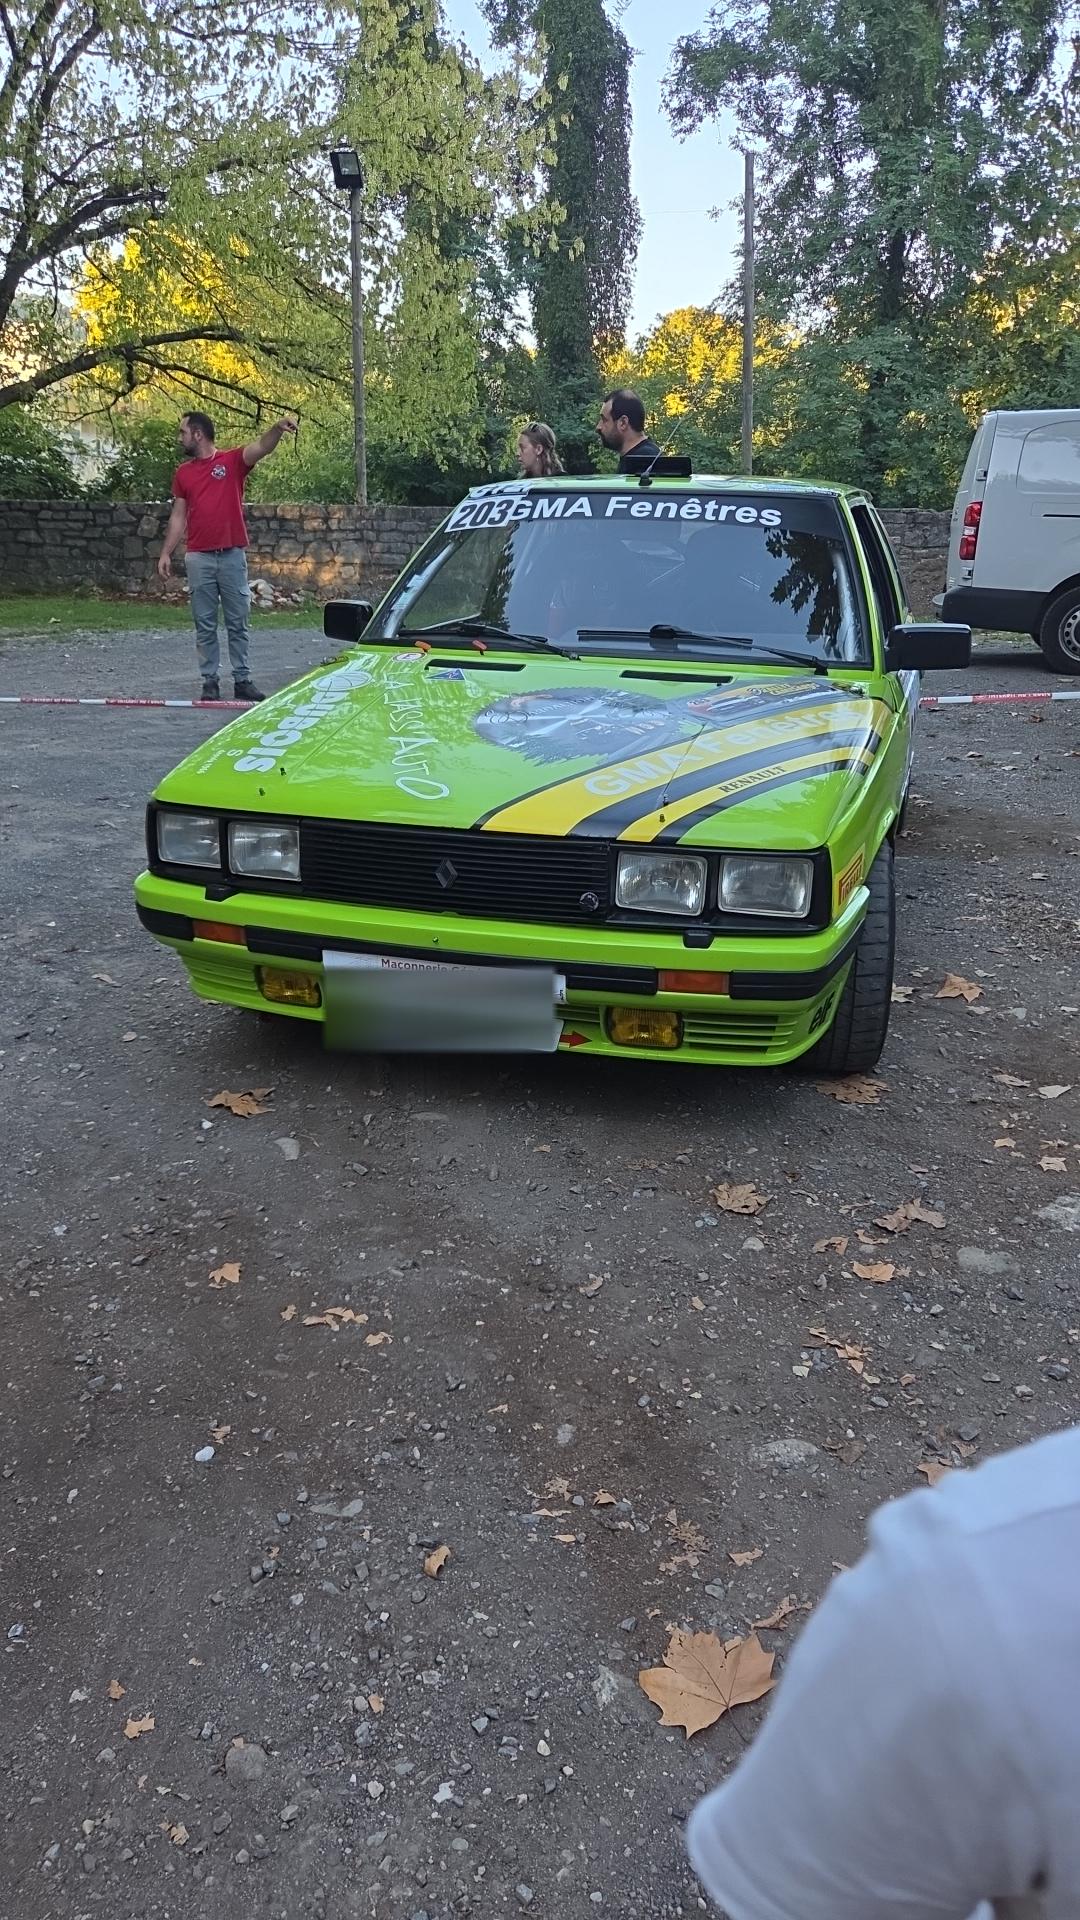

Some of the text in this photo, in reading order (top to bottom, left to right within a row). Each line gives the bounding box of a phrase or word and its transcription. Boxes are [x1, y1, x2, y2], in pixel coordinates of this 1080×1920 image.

[449, 499, 515, 528] 203
[510, 496, 782, 526] GMA Fenêtres
[584, 752, 704, 796] GMA
[718, 766, 787, 793] RENAULT
